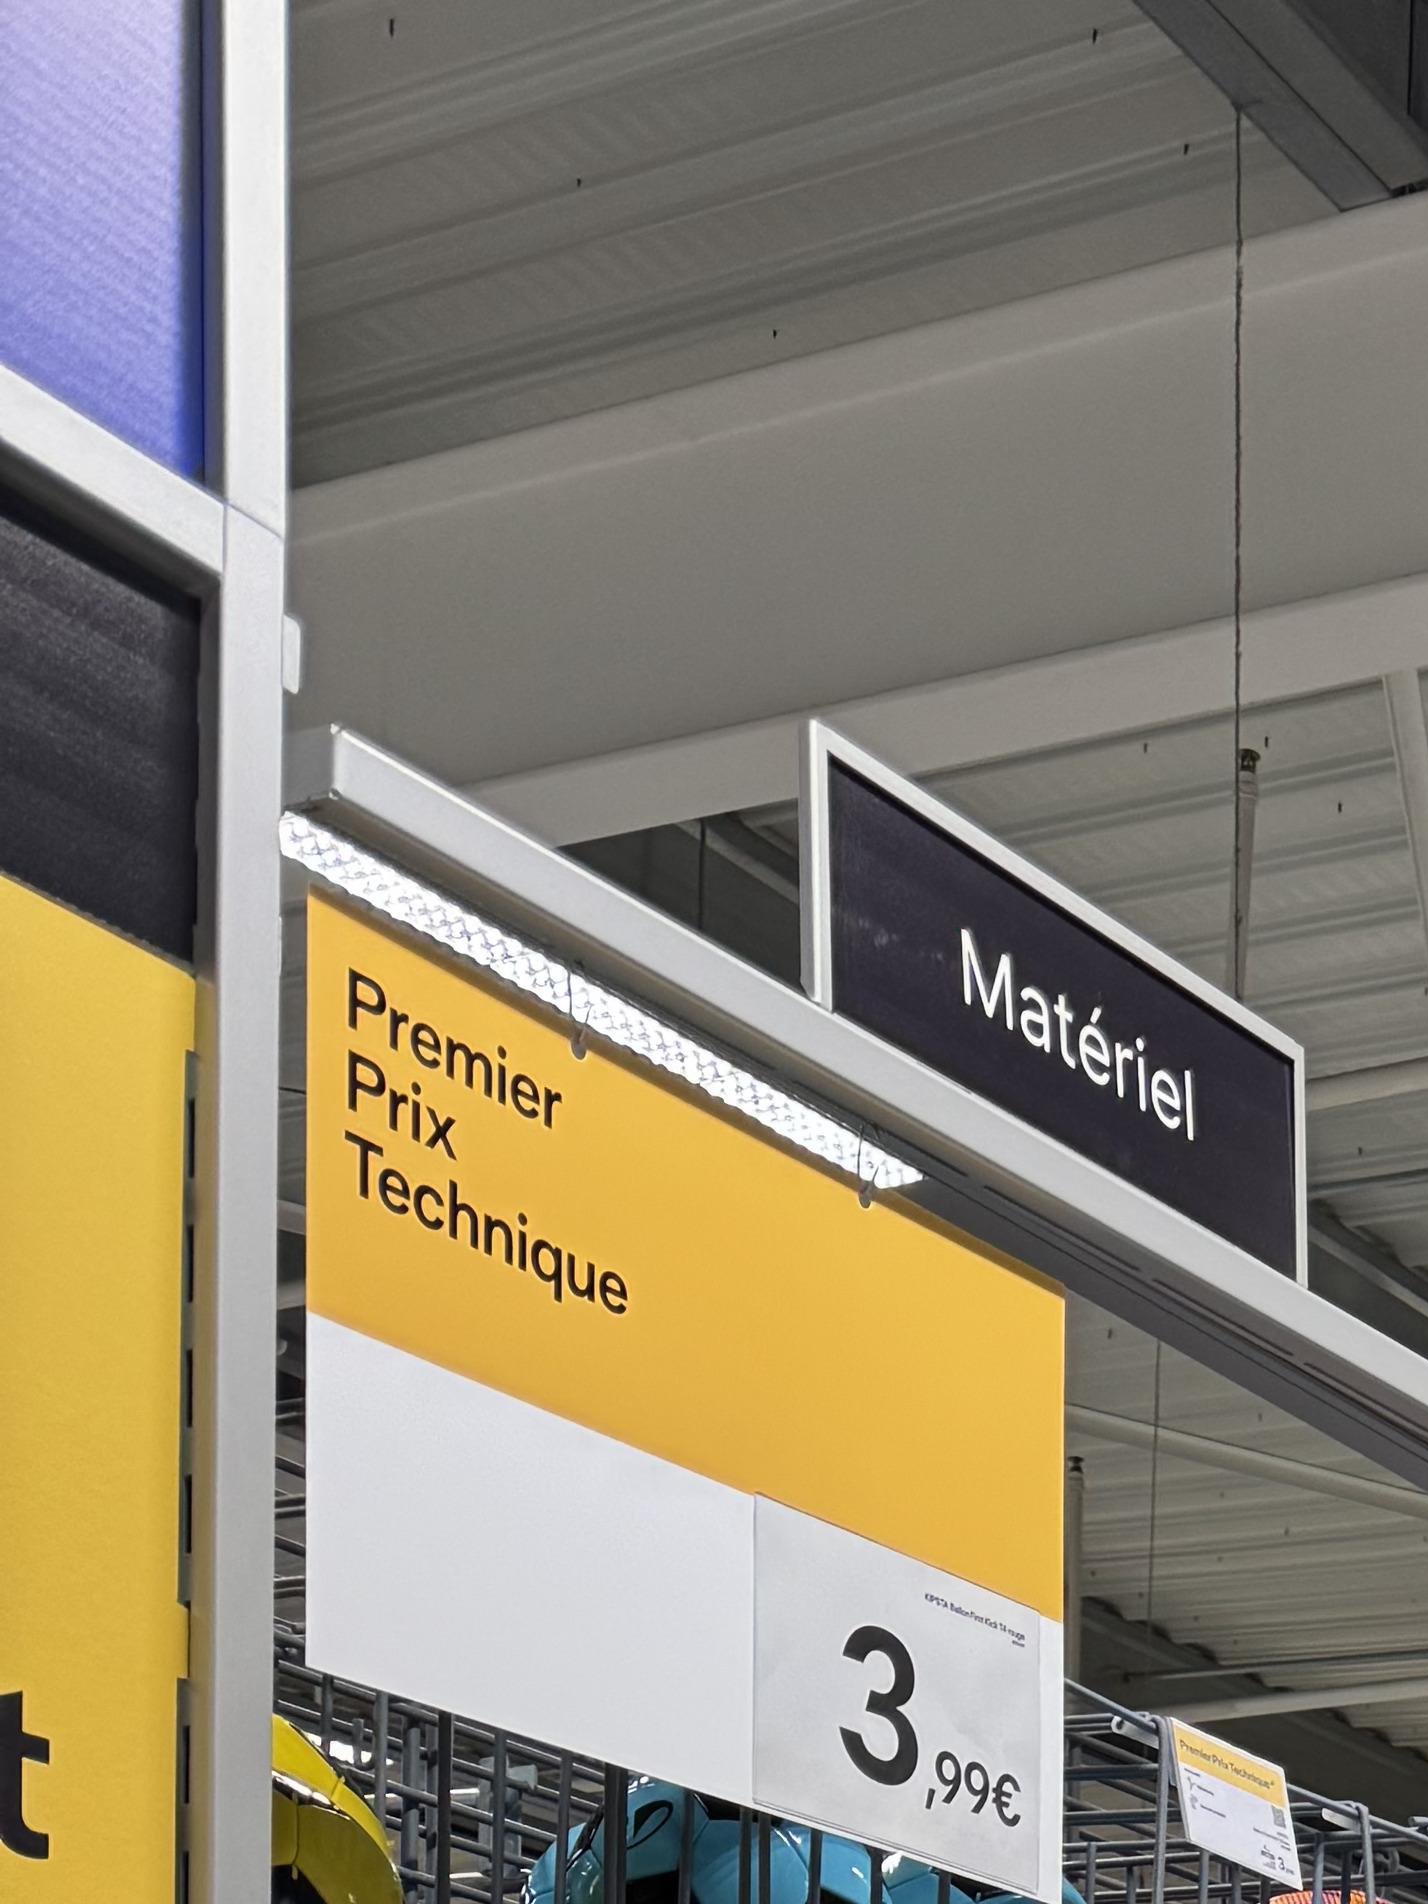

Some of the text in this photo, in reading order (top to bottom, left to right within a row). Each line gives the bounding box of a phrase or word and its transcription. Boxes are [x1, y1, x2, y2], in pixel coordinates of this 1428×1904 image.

[348, 967, 562, 1129] Premier
[348, 1049, 457, 1161] Prix
[961, 928, 1194, 1141] Matériel
[344, 1130, 628, 1315] Technique
[1179, 1739, 1211, 1762] Premier
[1212, 1754, 1228, 1770] Prix
